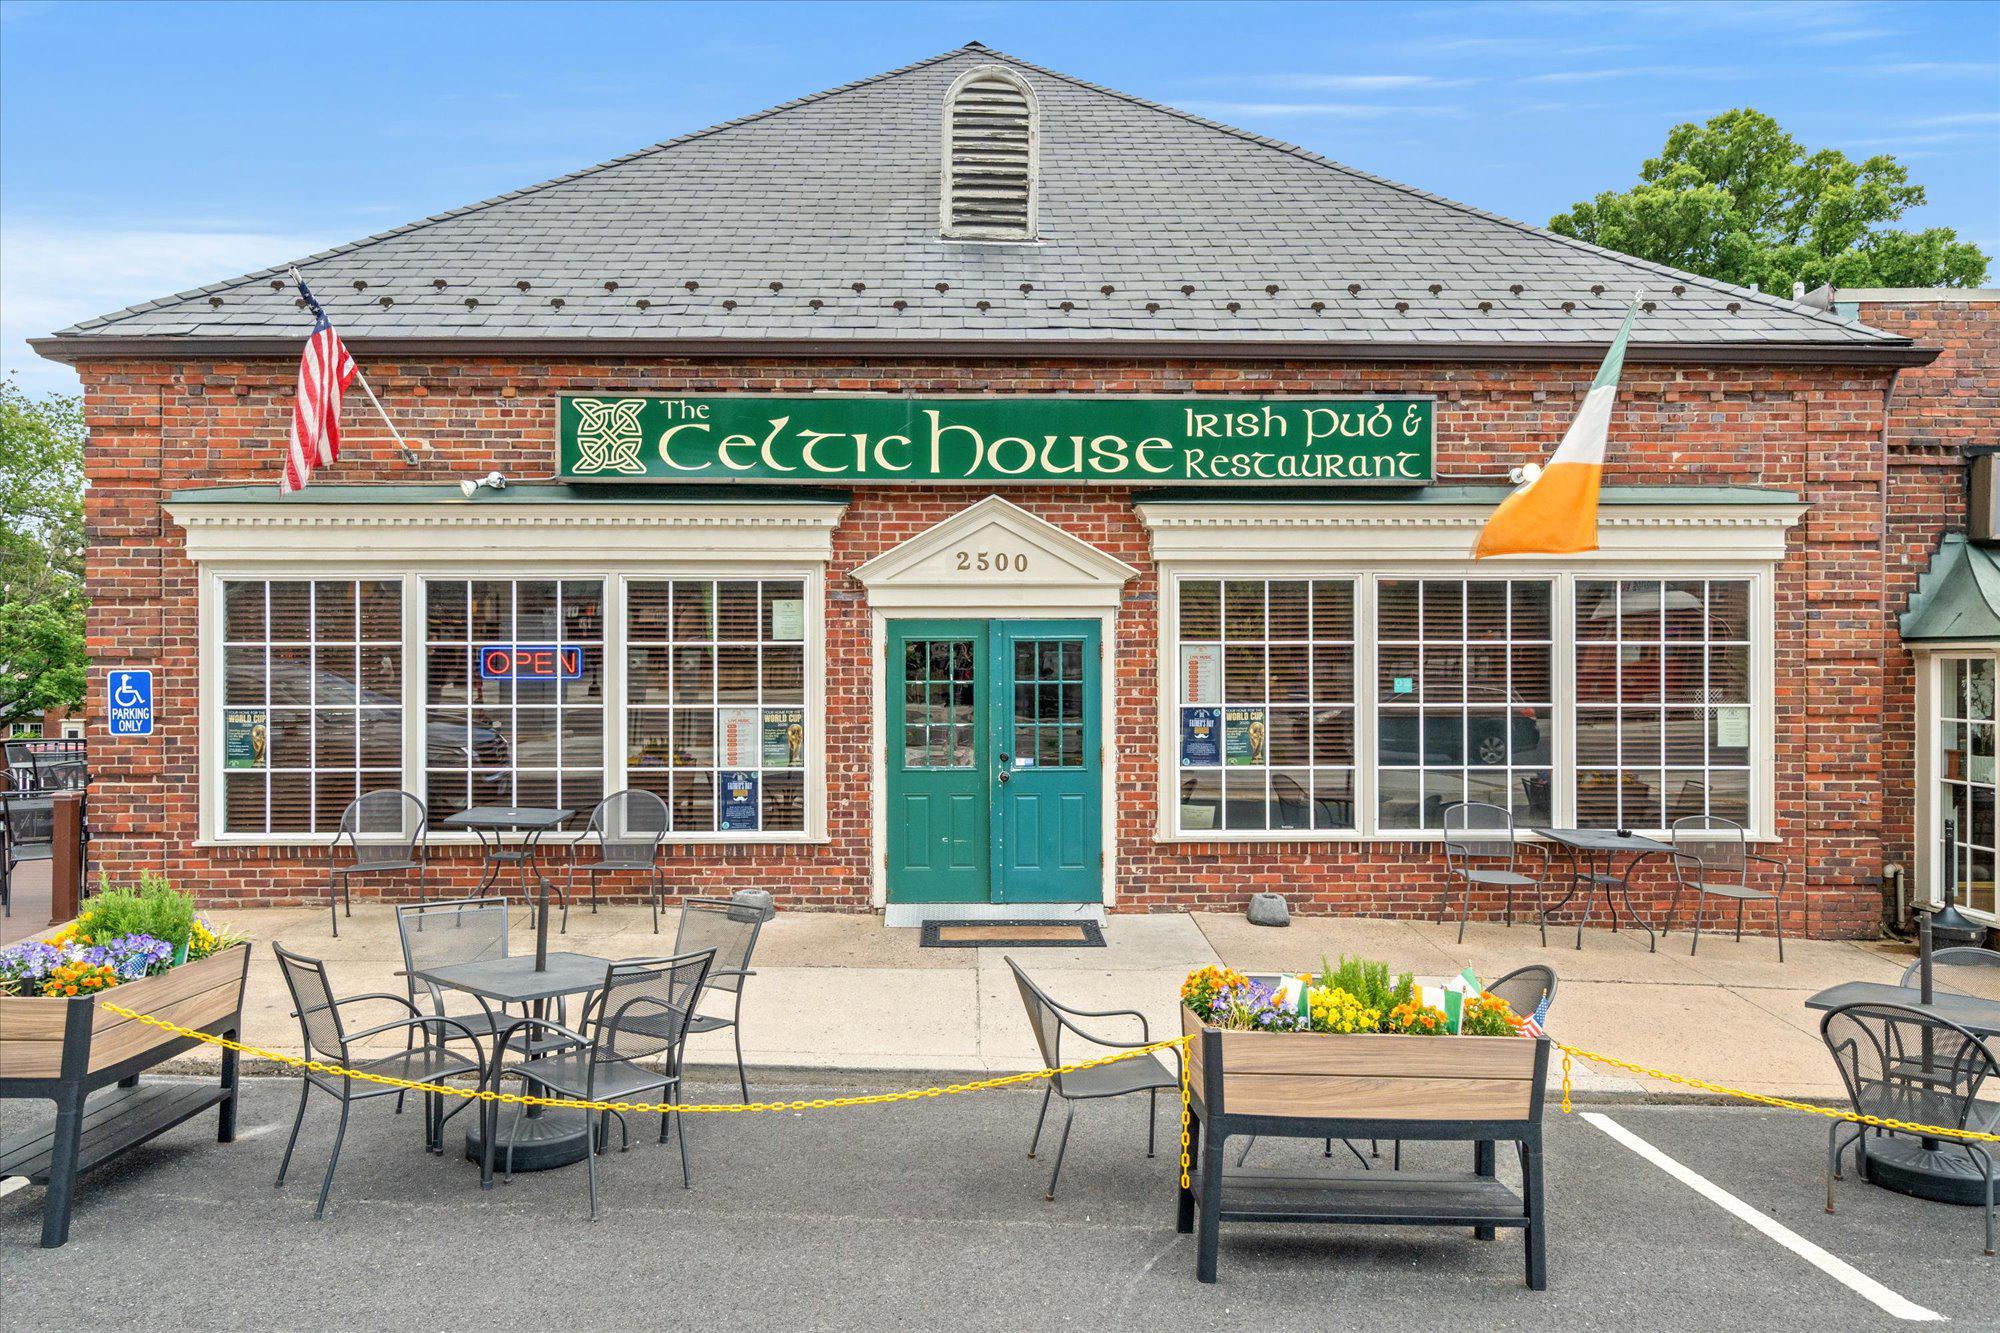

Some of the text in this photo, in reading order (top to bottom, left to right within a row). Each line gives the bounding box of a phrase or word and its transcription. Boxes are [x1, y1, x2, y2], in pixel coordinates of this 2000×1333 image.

[659, 399, 710, 419] The
[1184, 403, 1422, 447] Irish Pub &
[658, 415, 912, 473] Celtic
[1183, 448, 1421, 478] Restaurant
[956, 551, 1028, 572] 2500
[486, 651, 576, 674] OPEN
[112, 707, 150, 720] PARKING
[228, 714, 266, 723] WORLD CUP
[764, 714, 802, 723] WORLD CUP
[1226, 712, 1264, 721] WORLD CUP
[118, 720, 143, 732] ONLY
